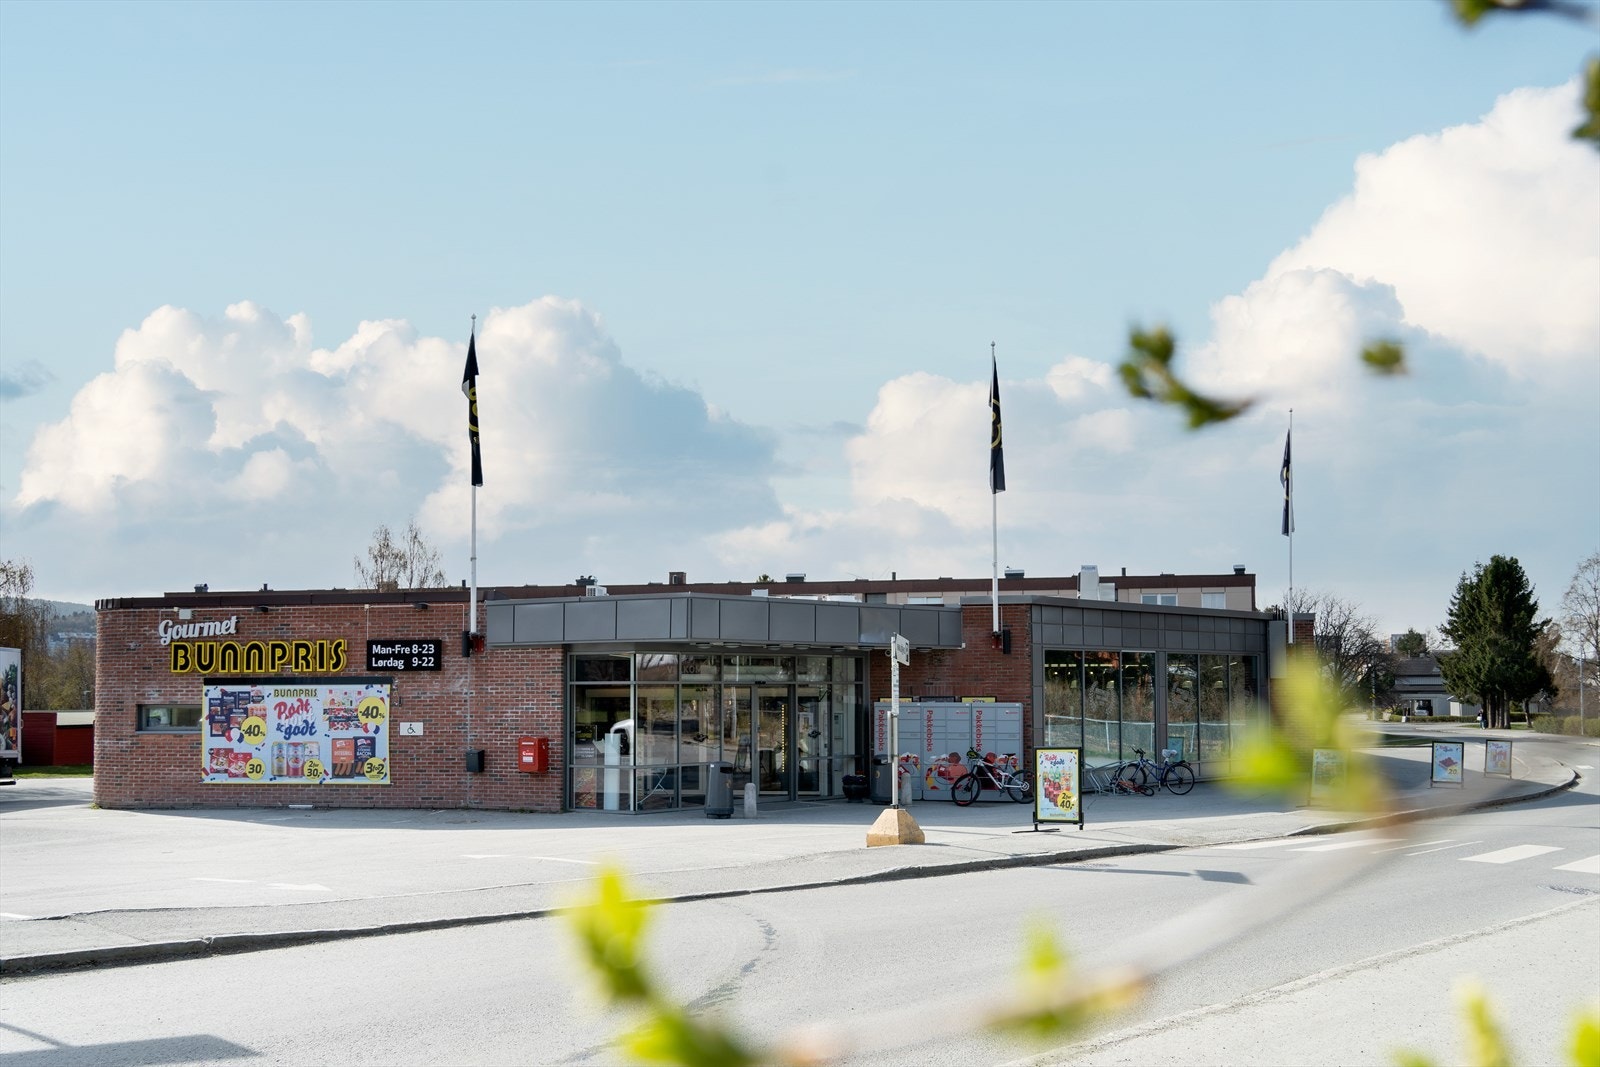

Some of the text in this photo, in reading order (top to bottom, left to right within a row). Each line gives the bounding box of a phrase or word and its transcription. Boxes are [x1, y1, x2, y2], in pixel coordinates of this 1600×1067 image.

[158, 615, 237, 645] Gourmet
[372, 644, 435, 654] Man-Fre 8-23
[170, 638, 347, 674] BUNNPRIS
[372, 657, 435, 669] Lørdag 9-22
[360, 706, 385, 719] -40%
[243, 725, 266, 737] -40%
[284, 719, 317, 740] godt
